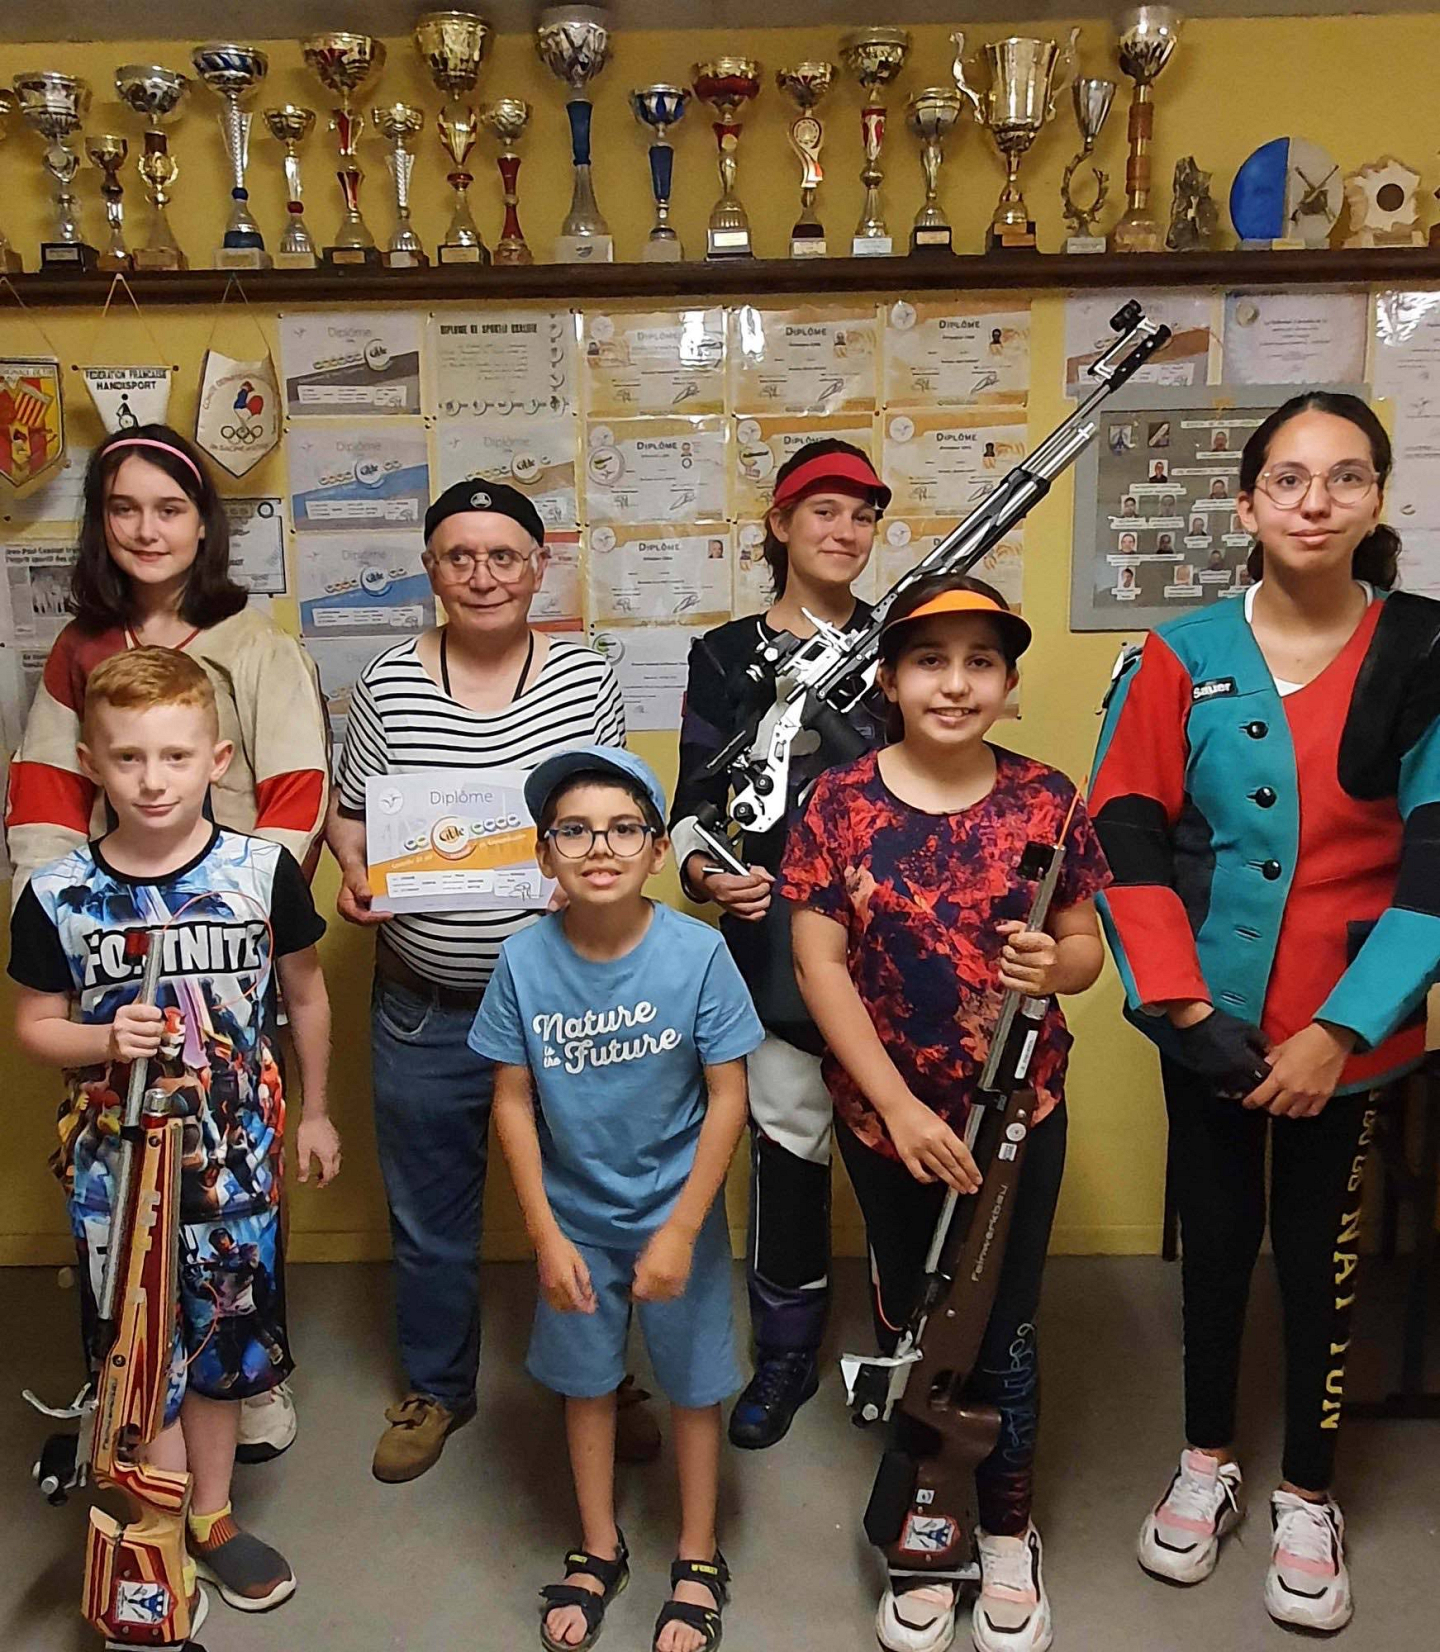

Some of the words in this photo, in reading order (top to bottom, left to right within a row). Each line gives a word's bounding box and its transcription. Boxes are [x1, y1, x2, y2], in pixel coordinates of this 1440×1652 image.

[939, 319, 980, 329] DIPLÔME
[786, 326, 827, 336] DIPLÔME
[97, 381, 156, 390] HANDISPORT
[937, 432, 978, 442] DIPLÔME
[637, 441, 678, 451] DIPLÔME
[638, 542, 680, 552] DIPLÔME
[1193, 683, 1231, 699] Sauer
[430, 790, 493, 806] Diplôme
[85, 924, 265, 987] FOTNITE
[532, 1001, 657, 1044] Nature
[563, 1028, 682, 1074] Future
[971, 1183, 1009, 1282] Feinwerkbau
